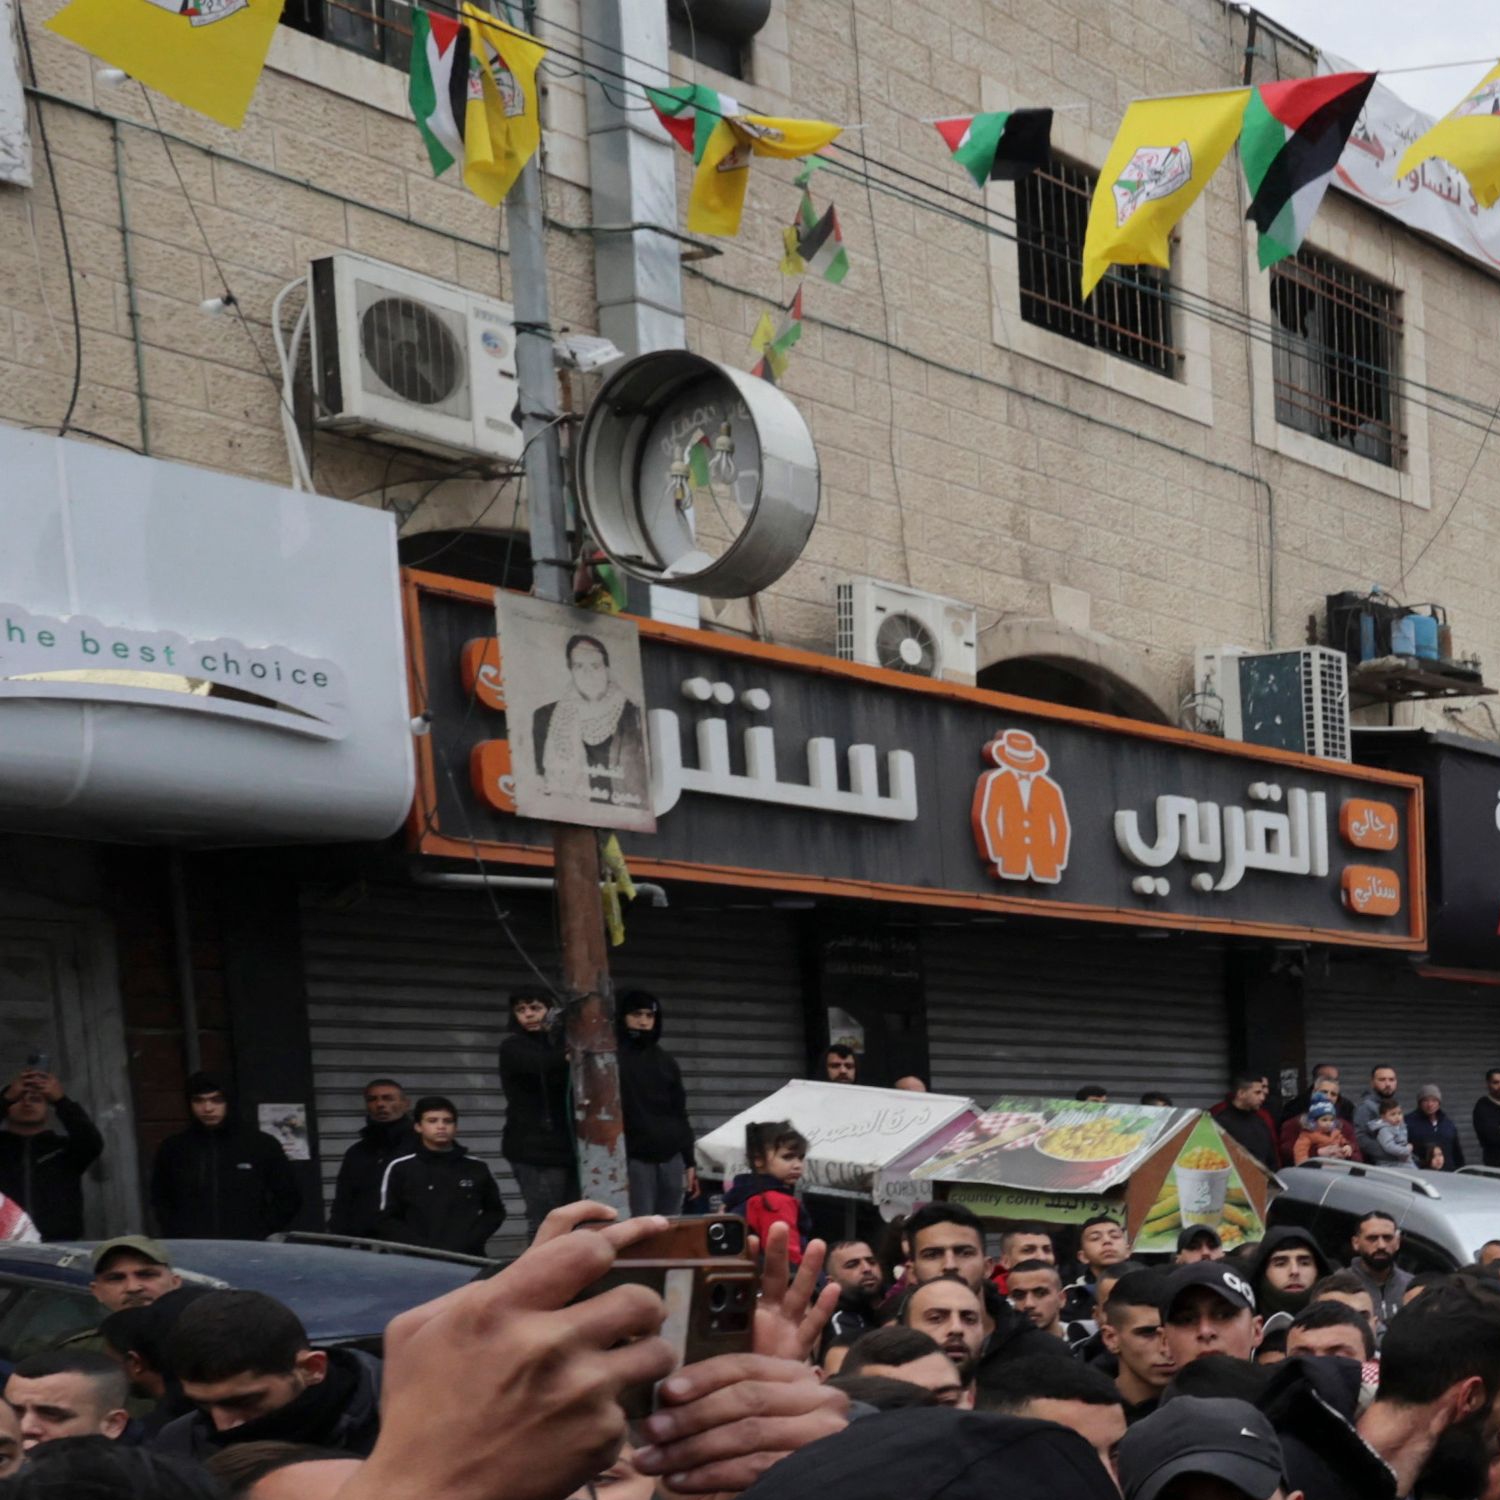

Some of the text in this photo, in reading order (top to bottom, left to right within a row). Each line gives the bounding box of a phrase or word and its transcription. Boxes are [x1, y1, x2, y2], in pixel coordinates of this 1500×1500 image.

[5, 618, 329, 688] he best choice
